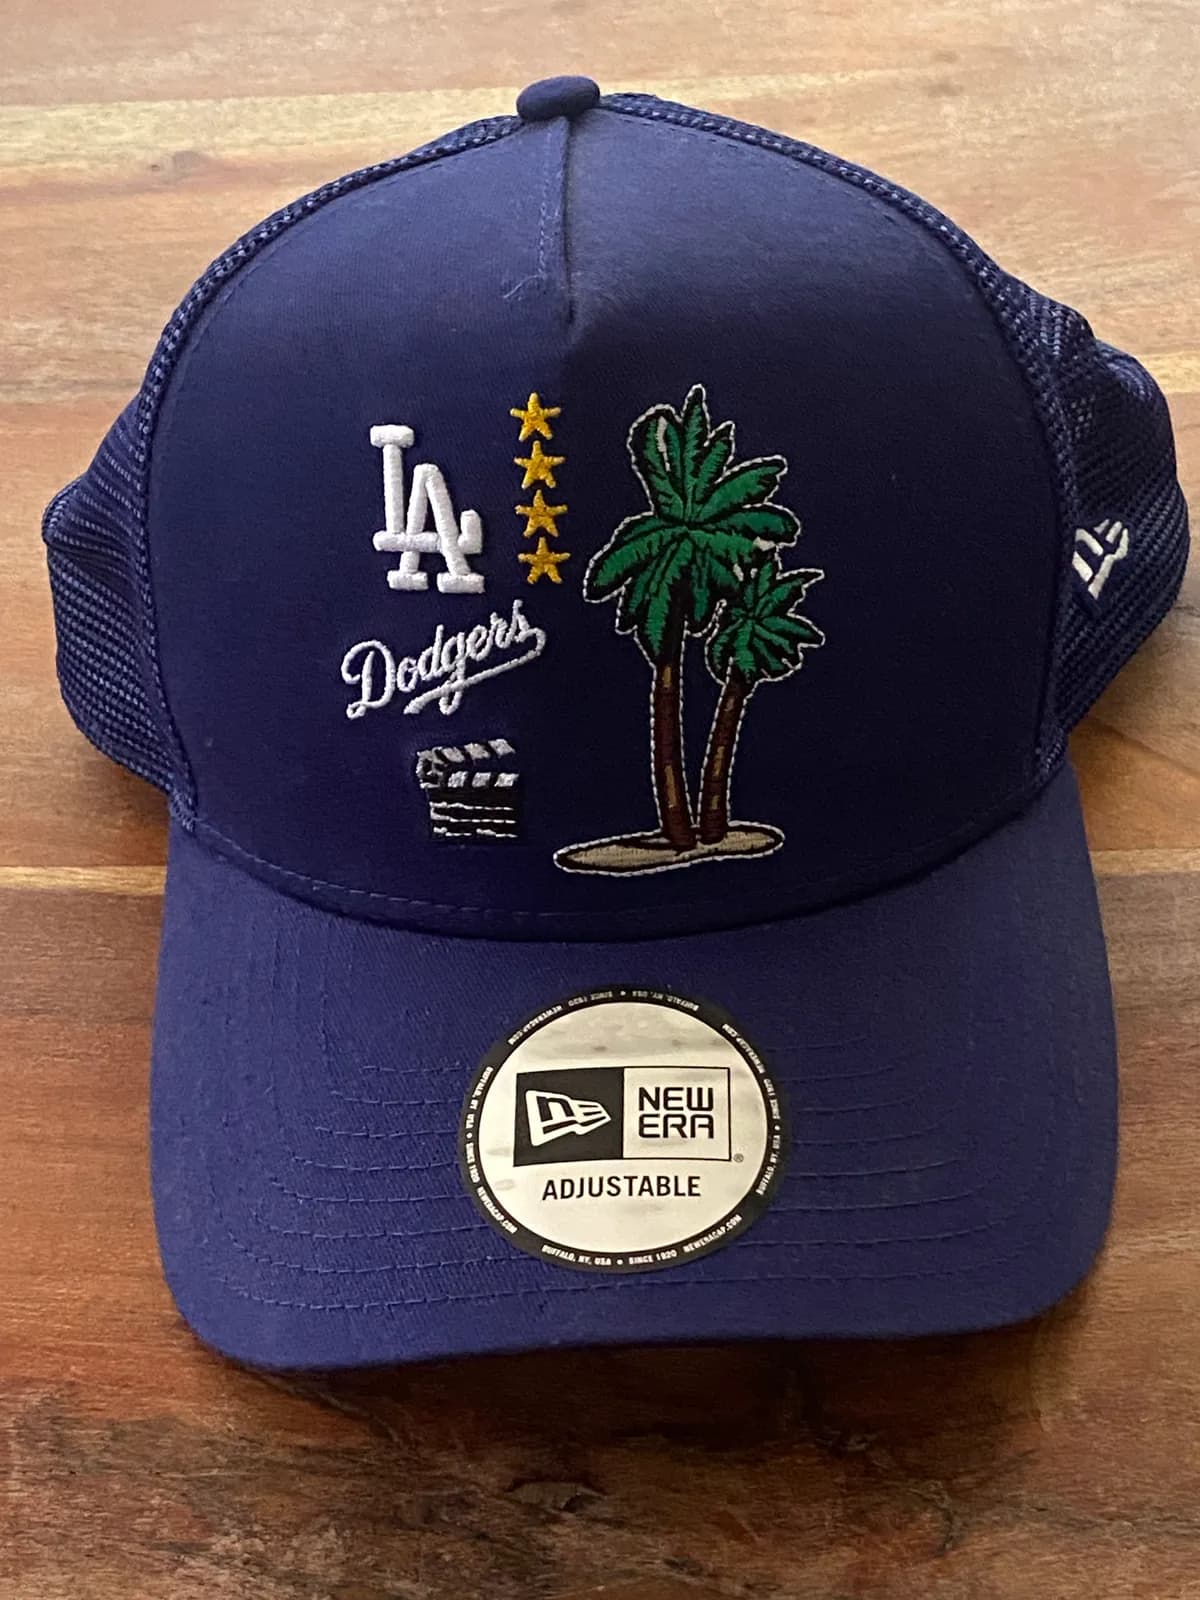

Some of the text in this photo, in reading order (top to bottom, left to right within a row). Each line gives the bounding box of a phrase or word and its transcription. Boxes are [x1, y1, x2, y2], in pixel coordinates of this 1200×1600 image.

[369, 424, 485, 594] LA
[340, 599, 548, 720] Dodgers
[638, 1086, 714, 1112] NEW
[638, 1113, 715, 1139] ERA
[542, 1175, 702, 1201] ADJUSTABLE
[594, 1257, 612, 1265] USA
[628, 1255, 654, 1265] SINCE
